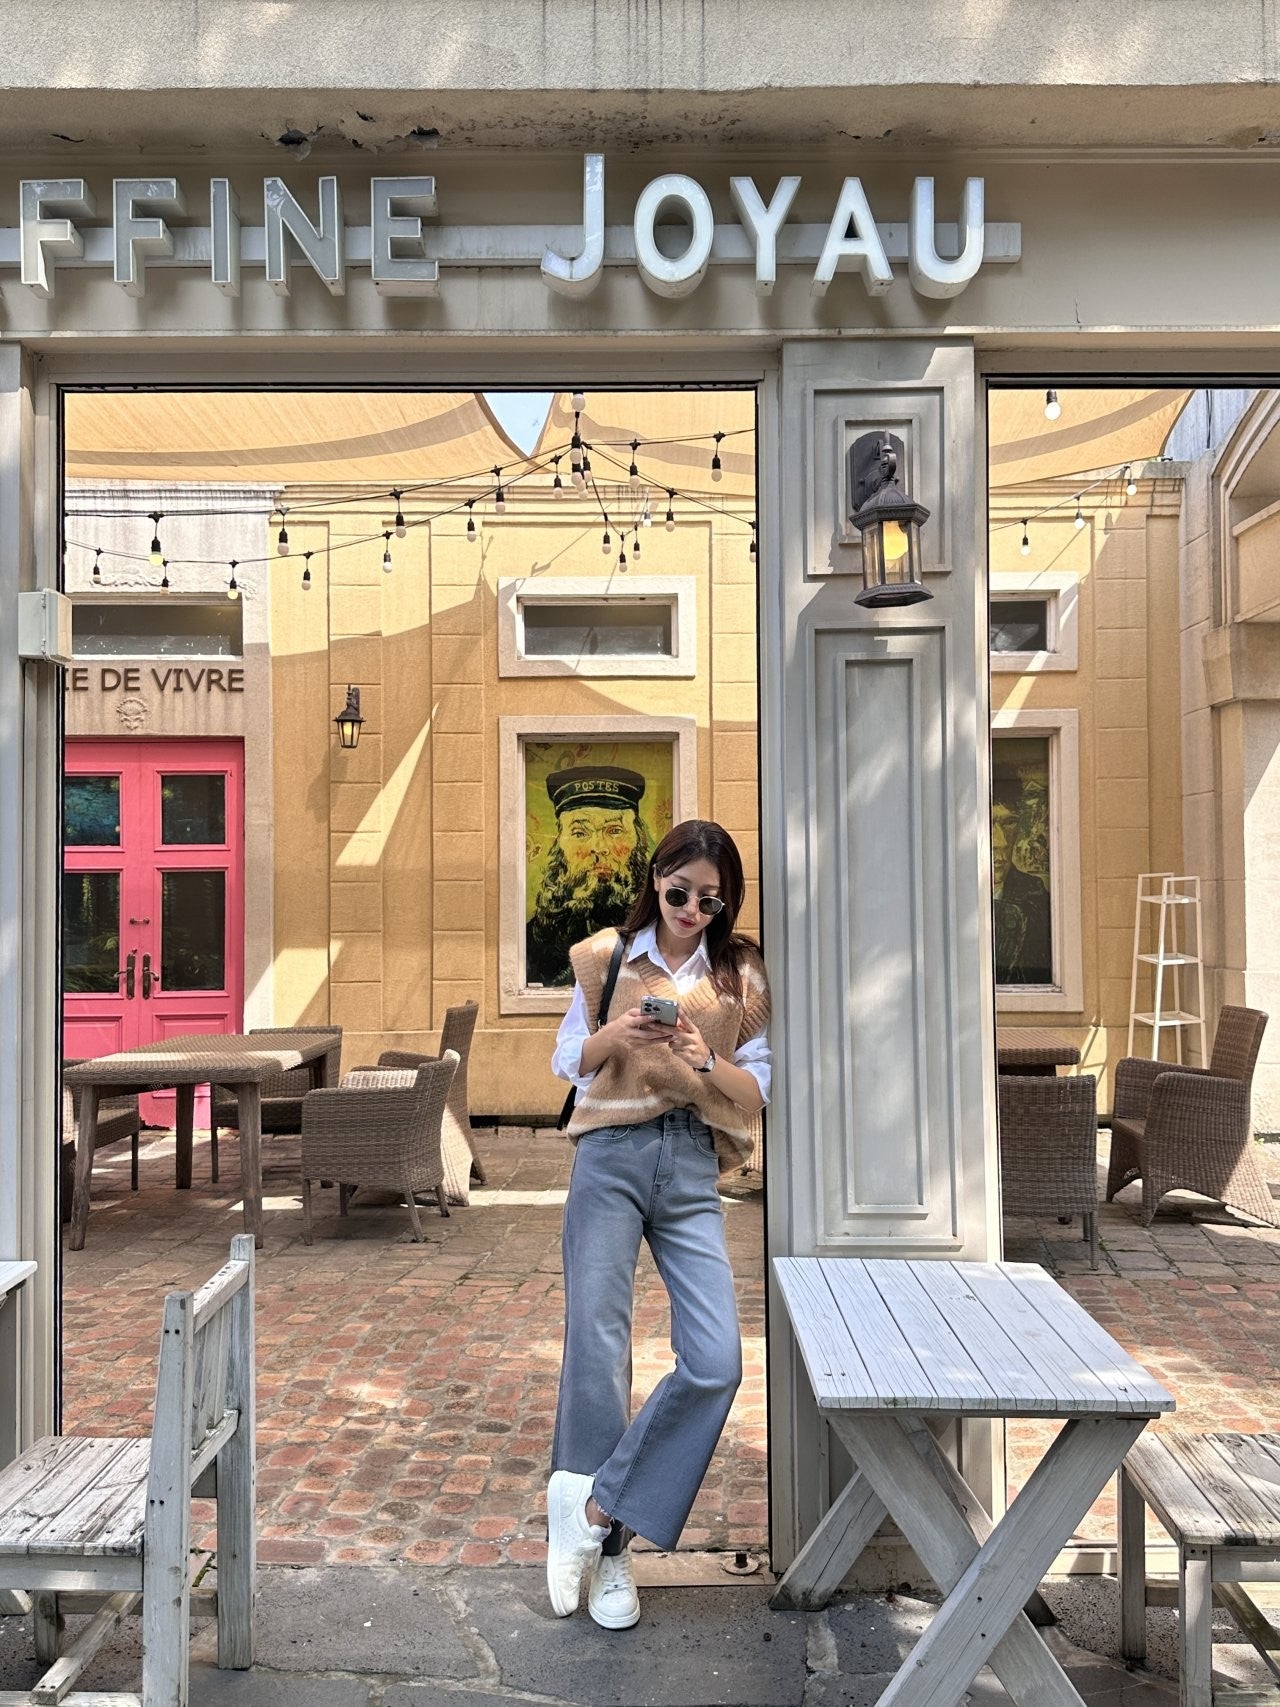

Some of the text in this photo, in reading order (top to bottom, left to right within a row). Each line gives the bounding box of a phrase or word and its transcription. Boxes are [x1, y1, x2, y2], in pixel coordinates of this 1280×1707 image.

[19, 153, 986, 294] FFINE JOYAU
[101, 667, 141, 691] DE
[151, 668, 245, 692] VIVRE
[574, 780, 619, 793] POSTES
